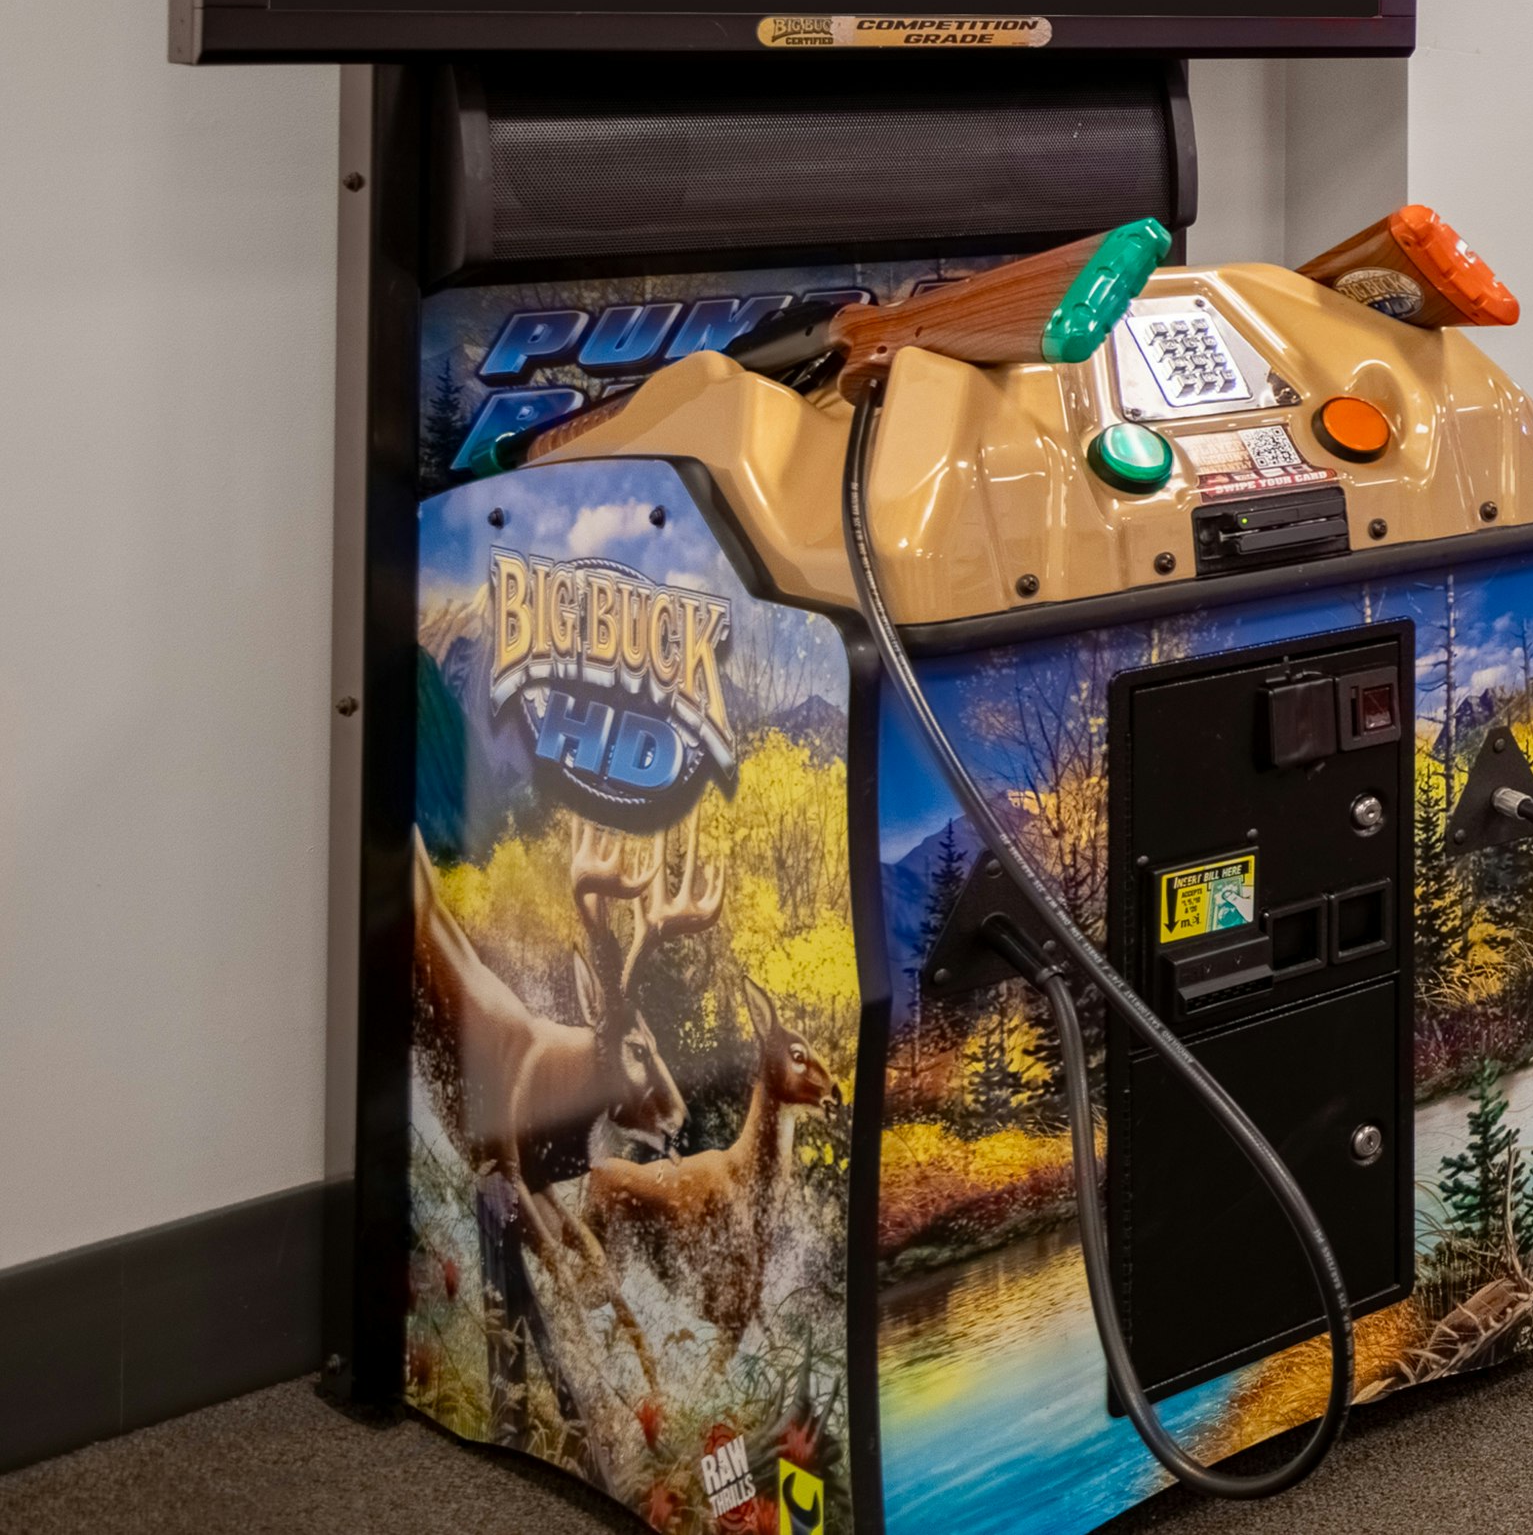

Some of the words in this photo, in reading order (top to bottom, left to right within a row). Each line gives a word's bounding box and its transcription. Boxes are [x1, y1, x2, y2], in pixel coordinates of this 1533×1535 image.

[856, 20, 1039, 30] COMPETITION
[786, 37, 834, 45] CERTIFIED
[904, 33, 995, 44] GRADE
[1215, 480, 1256, 494] SWIPE
[1259, 476, 1293, 488] YOUR
[1295, 471, 1328, 483] CARD
[491, 546, 577, 688] BIG
[583, 569, 736, 763] BUCK
[536, 690, 683, 790] HD
[1173, 874, 1202, 889] INSERT
[1203, 870, 1220, 882] BILL
[1222, 864, 1243, 877] HERE
[701, 1434, 749, 1496] RAW
[709, 1473, 756, 1519] THRILLS
